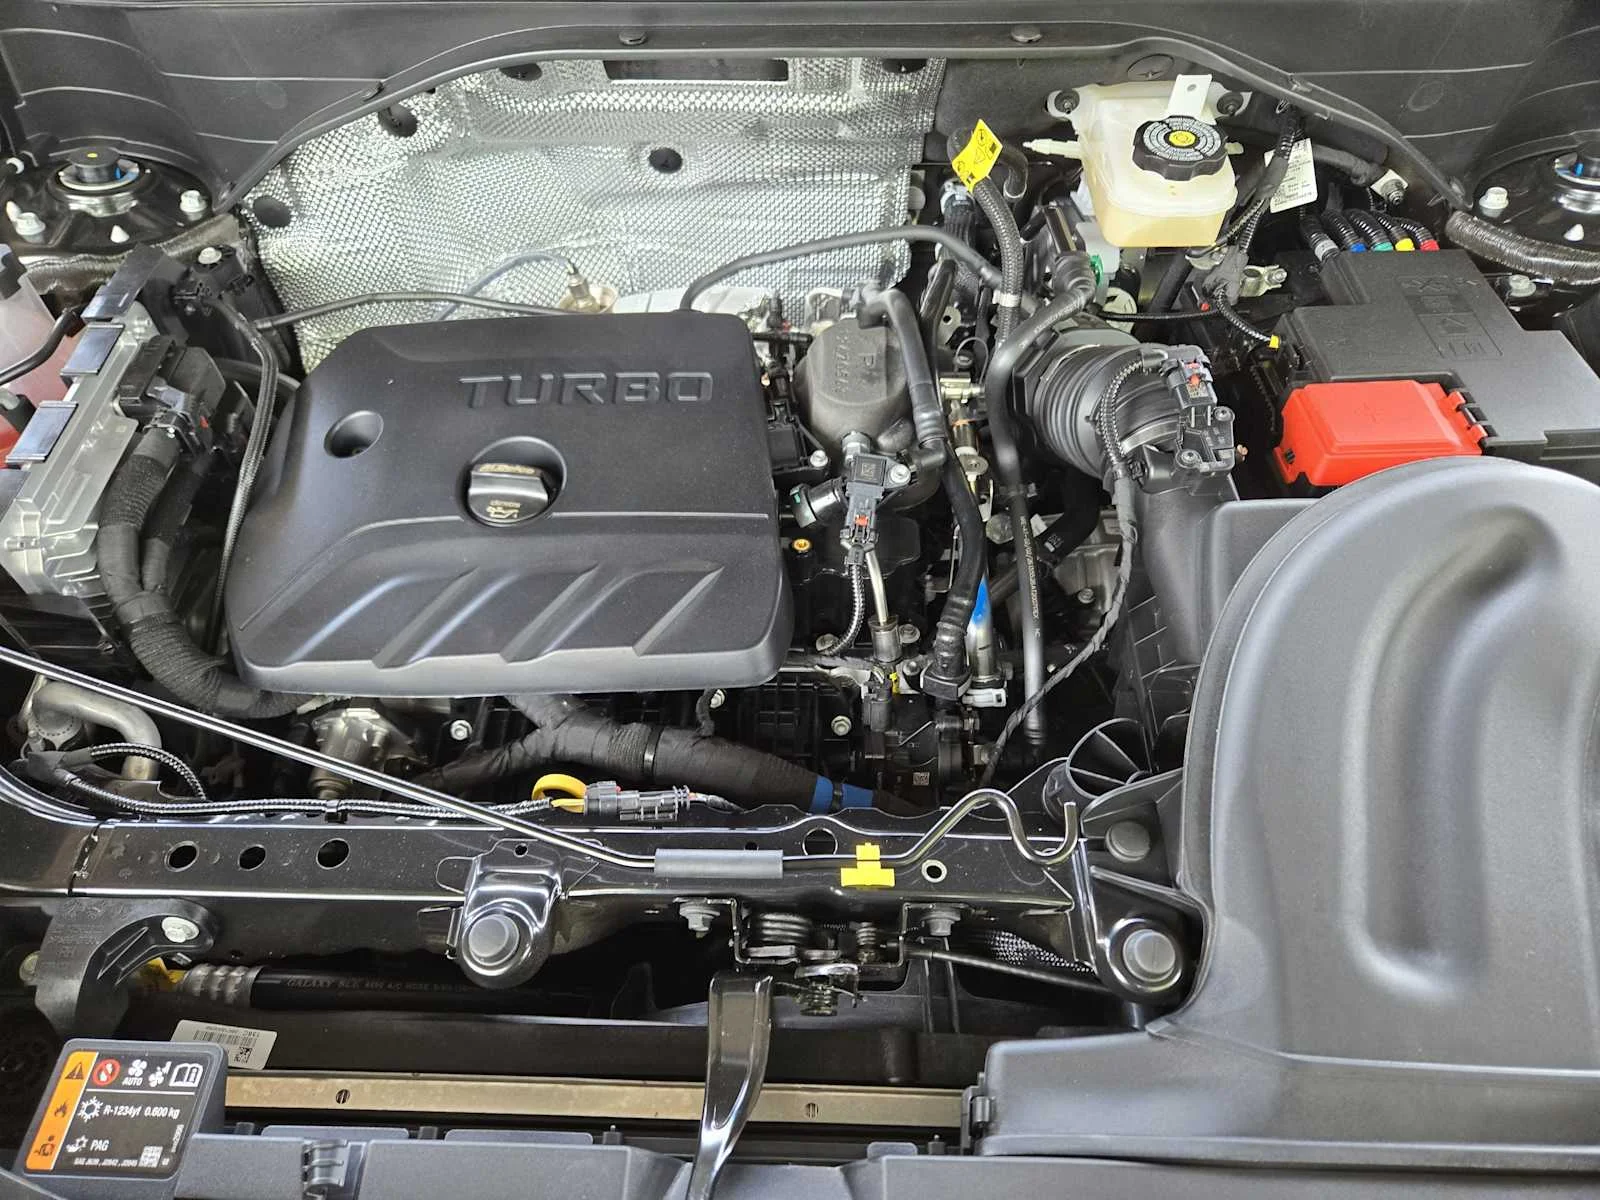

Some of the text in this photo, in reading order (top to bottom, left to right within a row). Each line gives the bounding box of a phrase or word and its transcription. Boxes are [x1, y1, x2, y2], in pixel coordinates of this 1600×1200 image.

[458, 371, 714, 408] TURBO
[122, 1077, 143, 1086] AUTO
[103, 1105, 142, 1118] R-1234yf
[168, 1107, 181, 1120] kg
[90, 1139, 110, 1151] PAG
